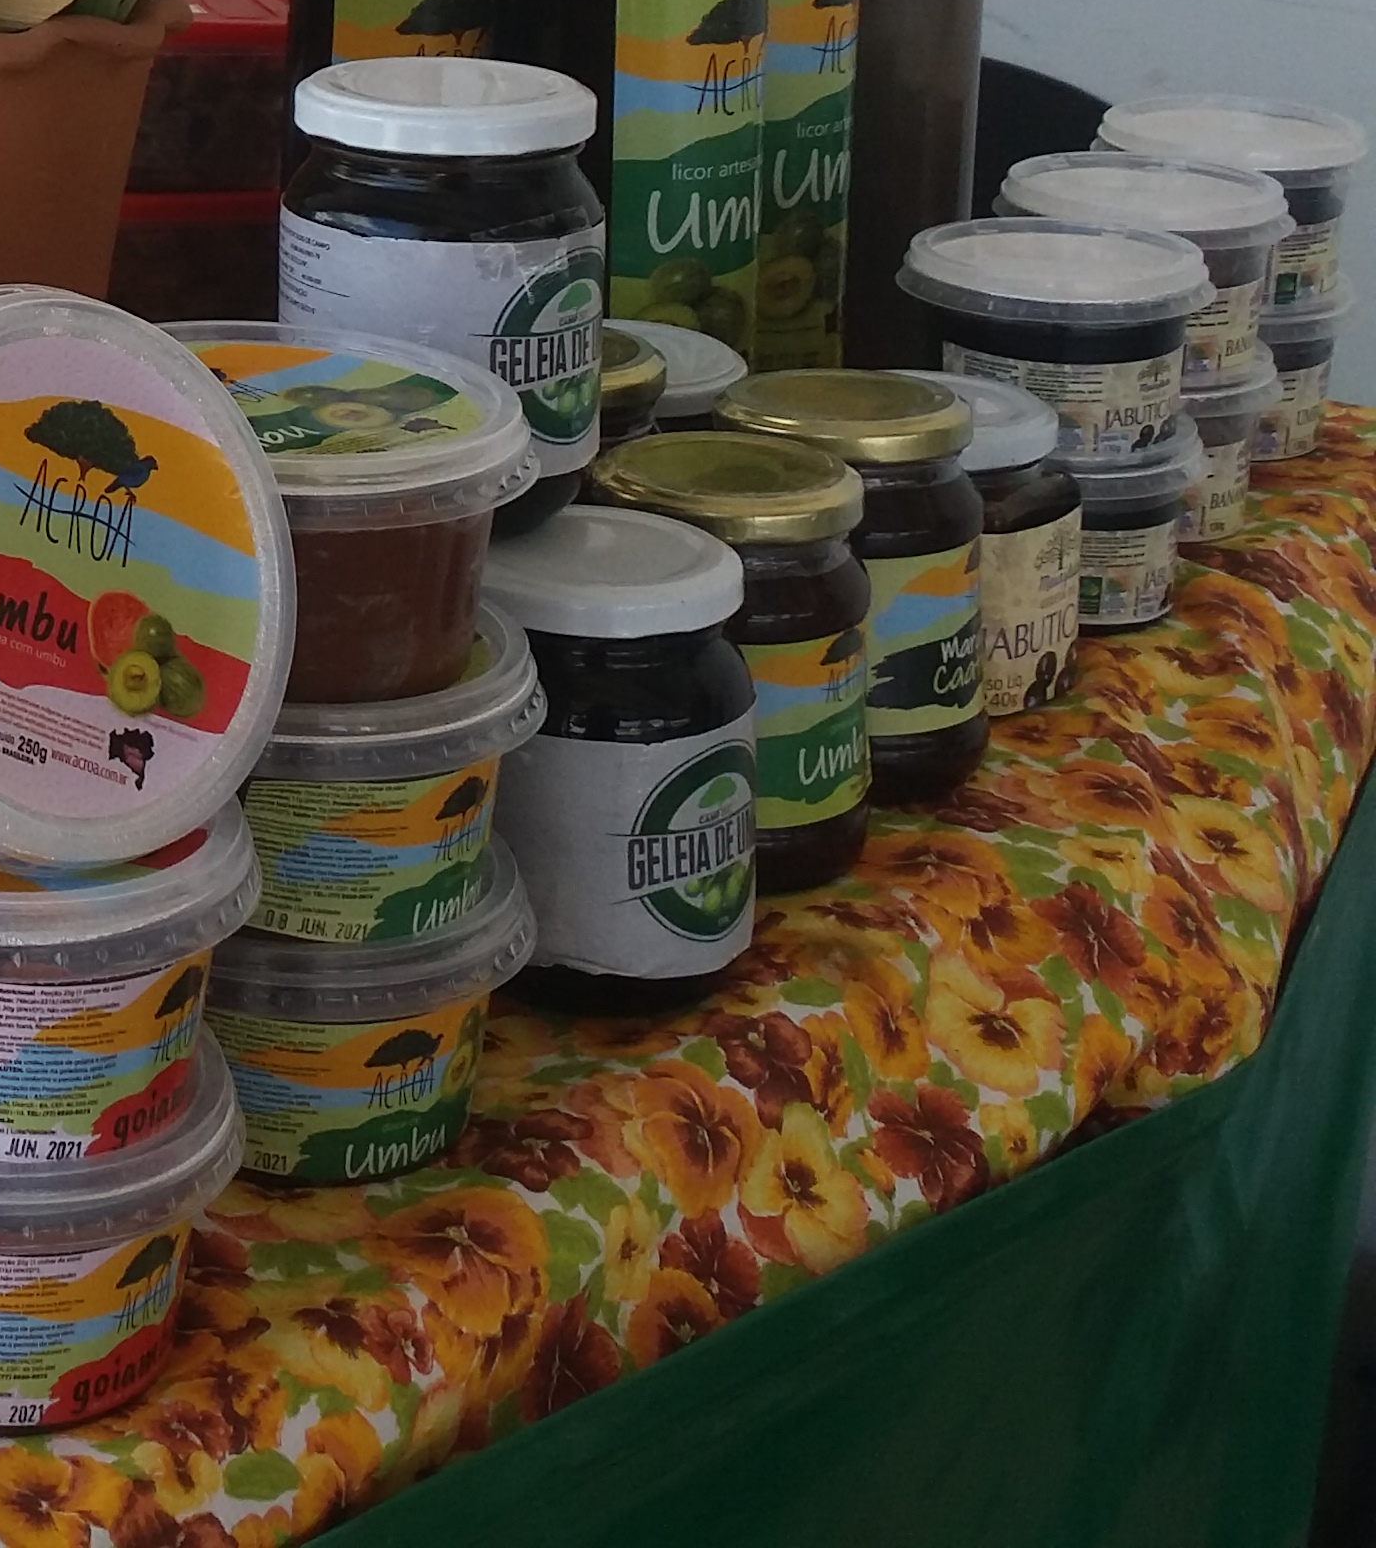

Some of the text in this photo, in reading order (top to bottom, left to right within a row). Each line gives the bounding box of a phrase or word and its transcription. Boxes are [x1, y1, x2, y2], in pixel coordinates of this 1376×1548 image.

[797, 121, 829, 138] licor
[672, 162, 714, 180] licor
[489, 330, 567, 388] GELEIA
[570, 325, 589, 372] DE
[14, 459, 137, 567] ACROA
[9, 632, 34, 652] com
[35, 638, 67, 668] umbu
[17, 736, 48, 763] 250g
[51, 748, 127, 785] www.acroa.com.br
[627, 819, 735, 891] GELEIA DE
[412, 876, 483, 936] Umbu
[264, 909, 368, 942] 08 JUN. 2021
[362, 1063, 436, 1109] ACROA
[5, 1138, 39, 1159] JUN.
[46, 1140, 83, 1160] 2021
[254, 1150, 288, 1172] 2021
[345, 1124, 445, 1179] Umbu
[9, 1403, 43, 1424] 2021
